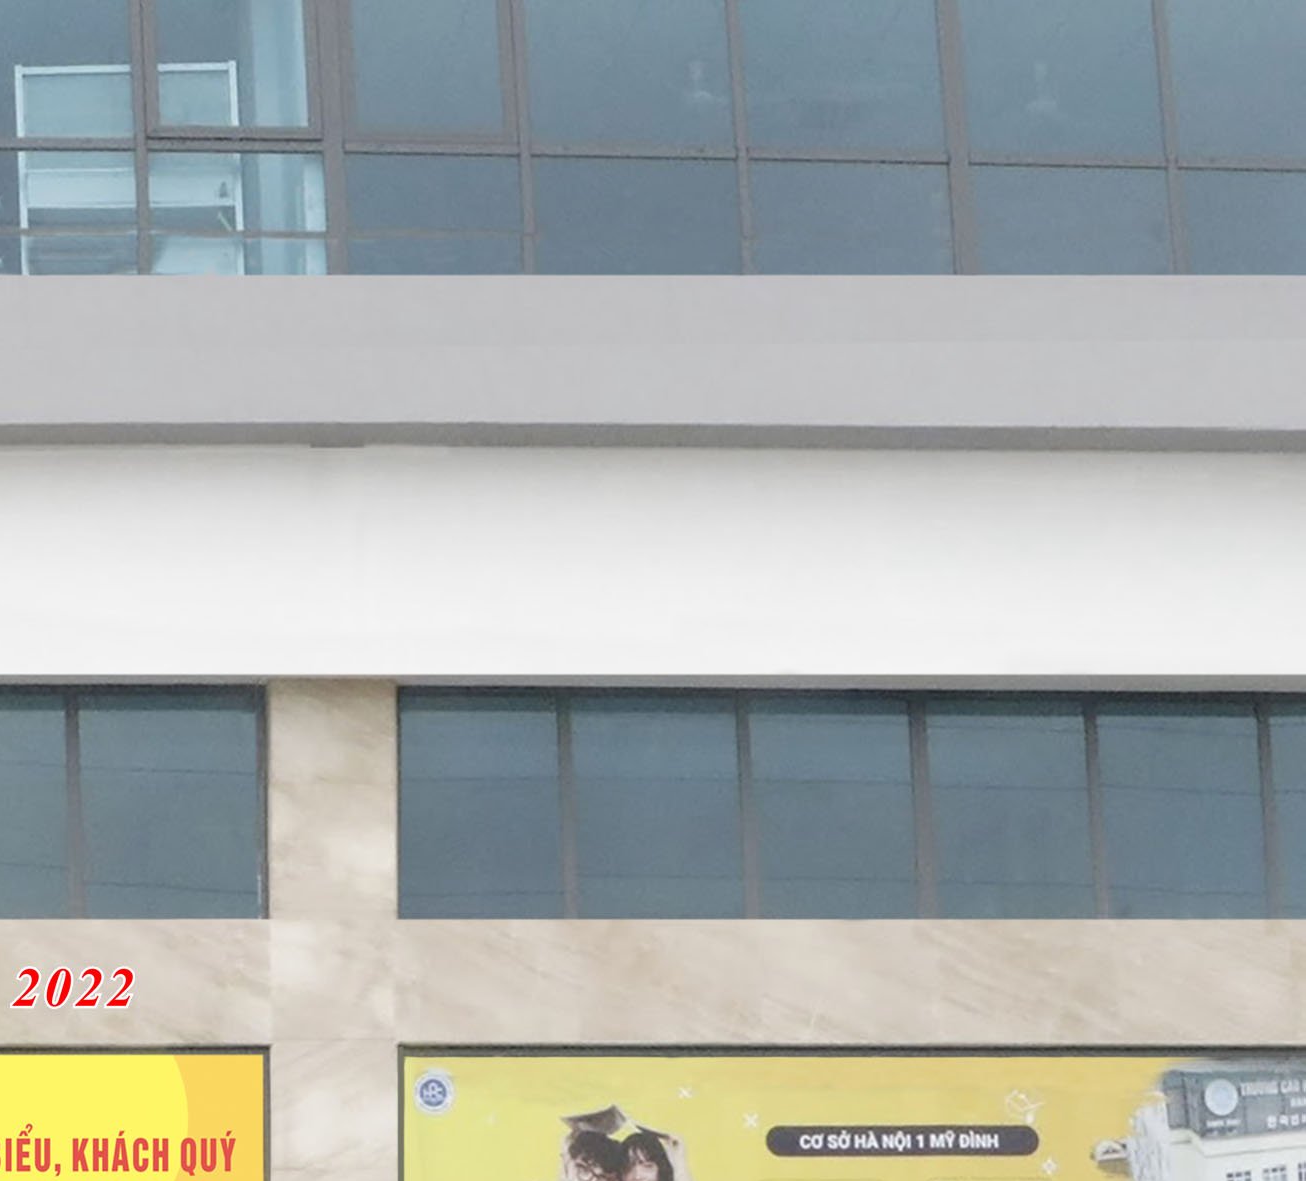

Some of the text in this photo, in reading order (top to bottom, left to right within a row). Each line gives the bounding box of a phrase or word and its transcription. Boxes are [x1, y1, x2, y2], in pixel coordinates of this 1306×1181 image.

[72, 1130, 169, 1173] KHÁCH
[180, 1130, 236, 1177] QUÝ
[799, 1130, 999, 1152] CƠ SỞ HÀ NỘI 1 MỸ ĐÌNH
